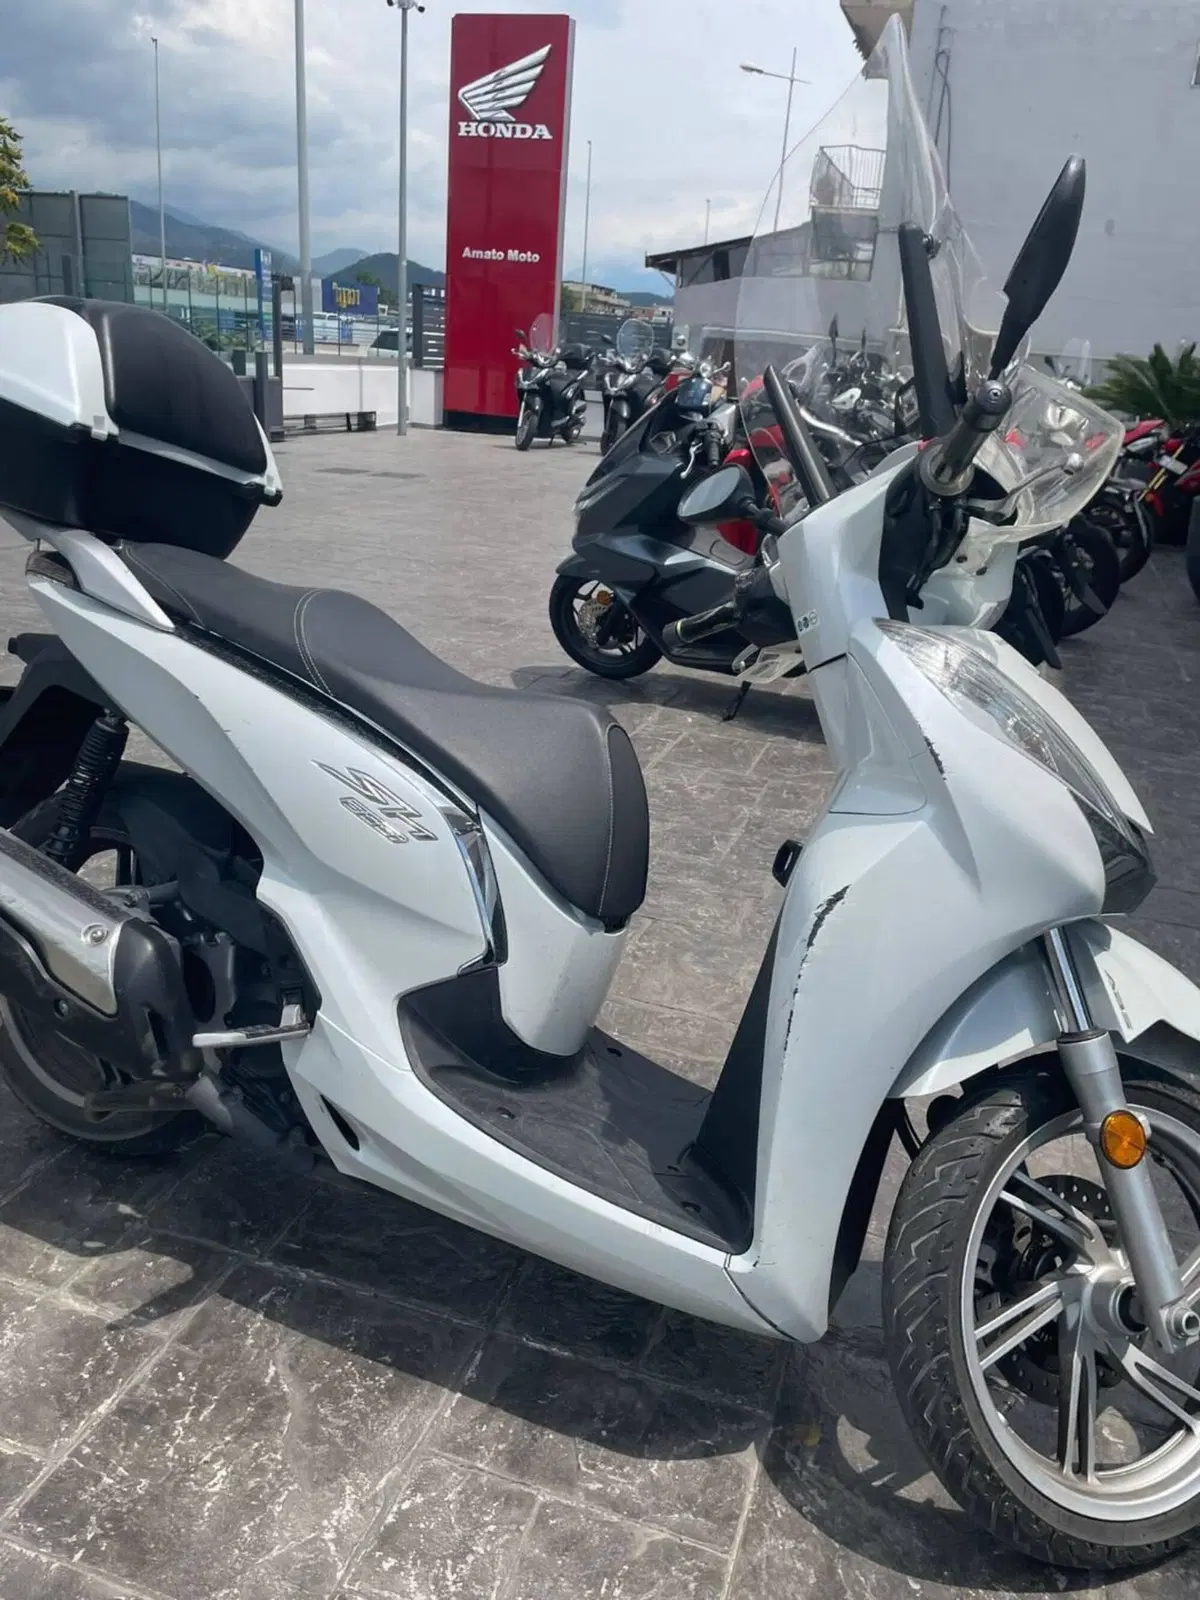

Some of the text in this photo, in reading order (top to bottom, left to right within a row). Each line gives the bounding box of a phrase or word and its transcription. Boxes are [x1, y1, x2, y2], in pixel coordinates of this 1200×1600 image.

[458, 121, 553, 140] HONDA
[462, 246, 540, 263] Amato Moto
